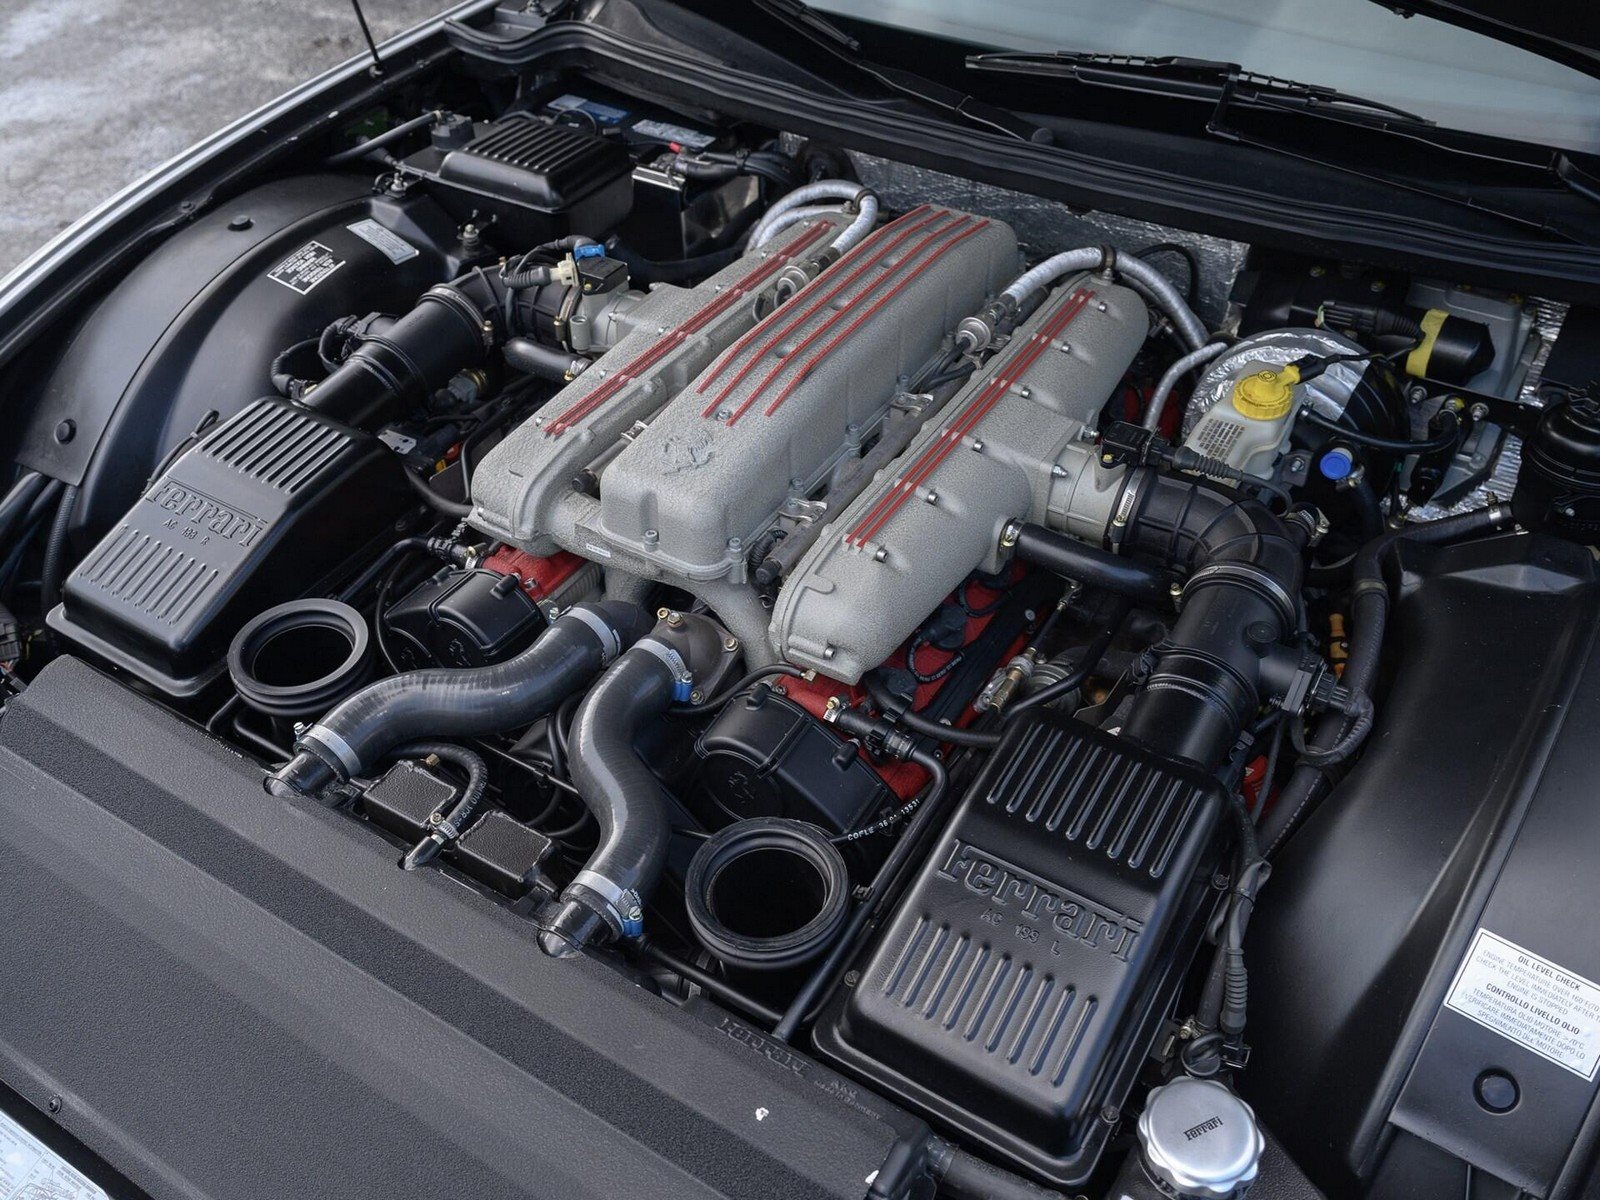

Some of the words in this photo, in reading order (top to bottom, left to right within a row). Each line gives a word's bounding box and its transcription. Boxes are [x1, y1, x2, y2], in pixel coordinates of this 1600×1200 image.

[145, 476, 268, 547] Ferrari
[847, 826, 875, 841] COFLE
[938, 839, 1143, 961] Ferrari
[1498, 966, 1510, 976] THE
[1510, 973, 1531, 987] LEVEL
[1530, 983, 1573, 1008] IMMEDIATELY
[1572, 1004, 1594, 1019] AFTER
[1517, 954, 1530, 966] OIL
[1531, 961, 1554, 978] LEVEL
[1554, 973, 1581, 991] CHECK
[1472, 987, 1518, 1015] TEMPERATURA
[1518, 1011, 1533, 1023] OLIO
[1533, 1019, 1561, 1037] MOTORE
[1485, 982, 1529, 1009] CONTROLLO
[1529, 1004, 1561, 1025] LIVELLO
[1560, 1020, 1580, 1035] OLIO
[1506, 980, 1529, 996] ENGINE
[1538, 996, 1568, 1015] STOPPED
[1476, 1009, 1522, 1036] SPEGNIMENTO
[1535, 1039, 1564, 1058] MOTORE
[1499, 1011, 1556, 1044] IMMEDIATAMENTE
[1555, 1040, 1575, 1054] DOPO
[1575, 1050, 1585, 1060] LO
[1183, 1115, 1224, 1141] Ferrari
